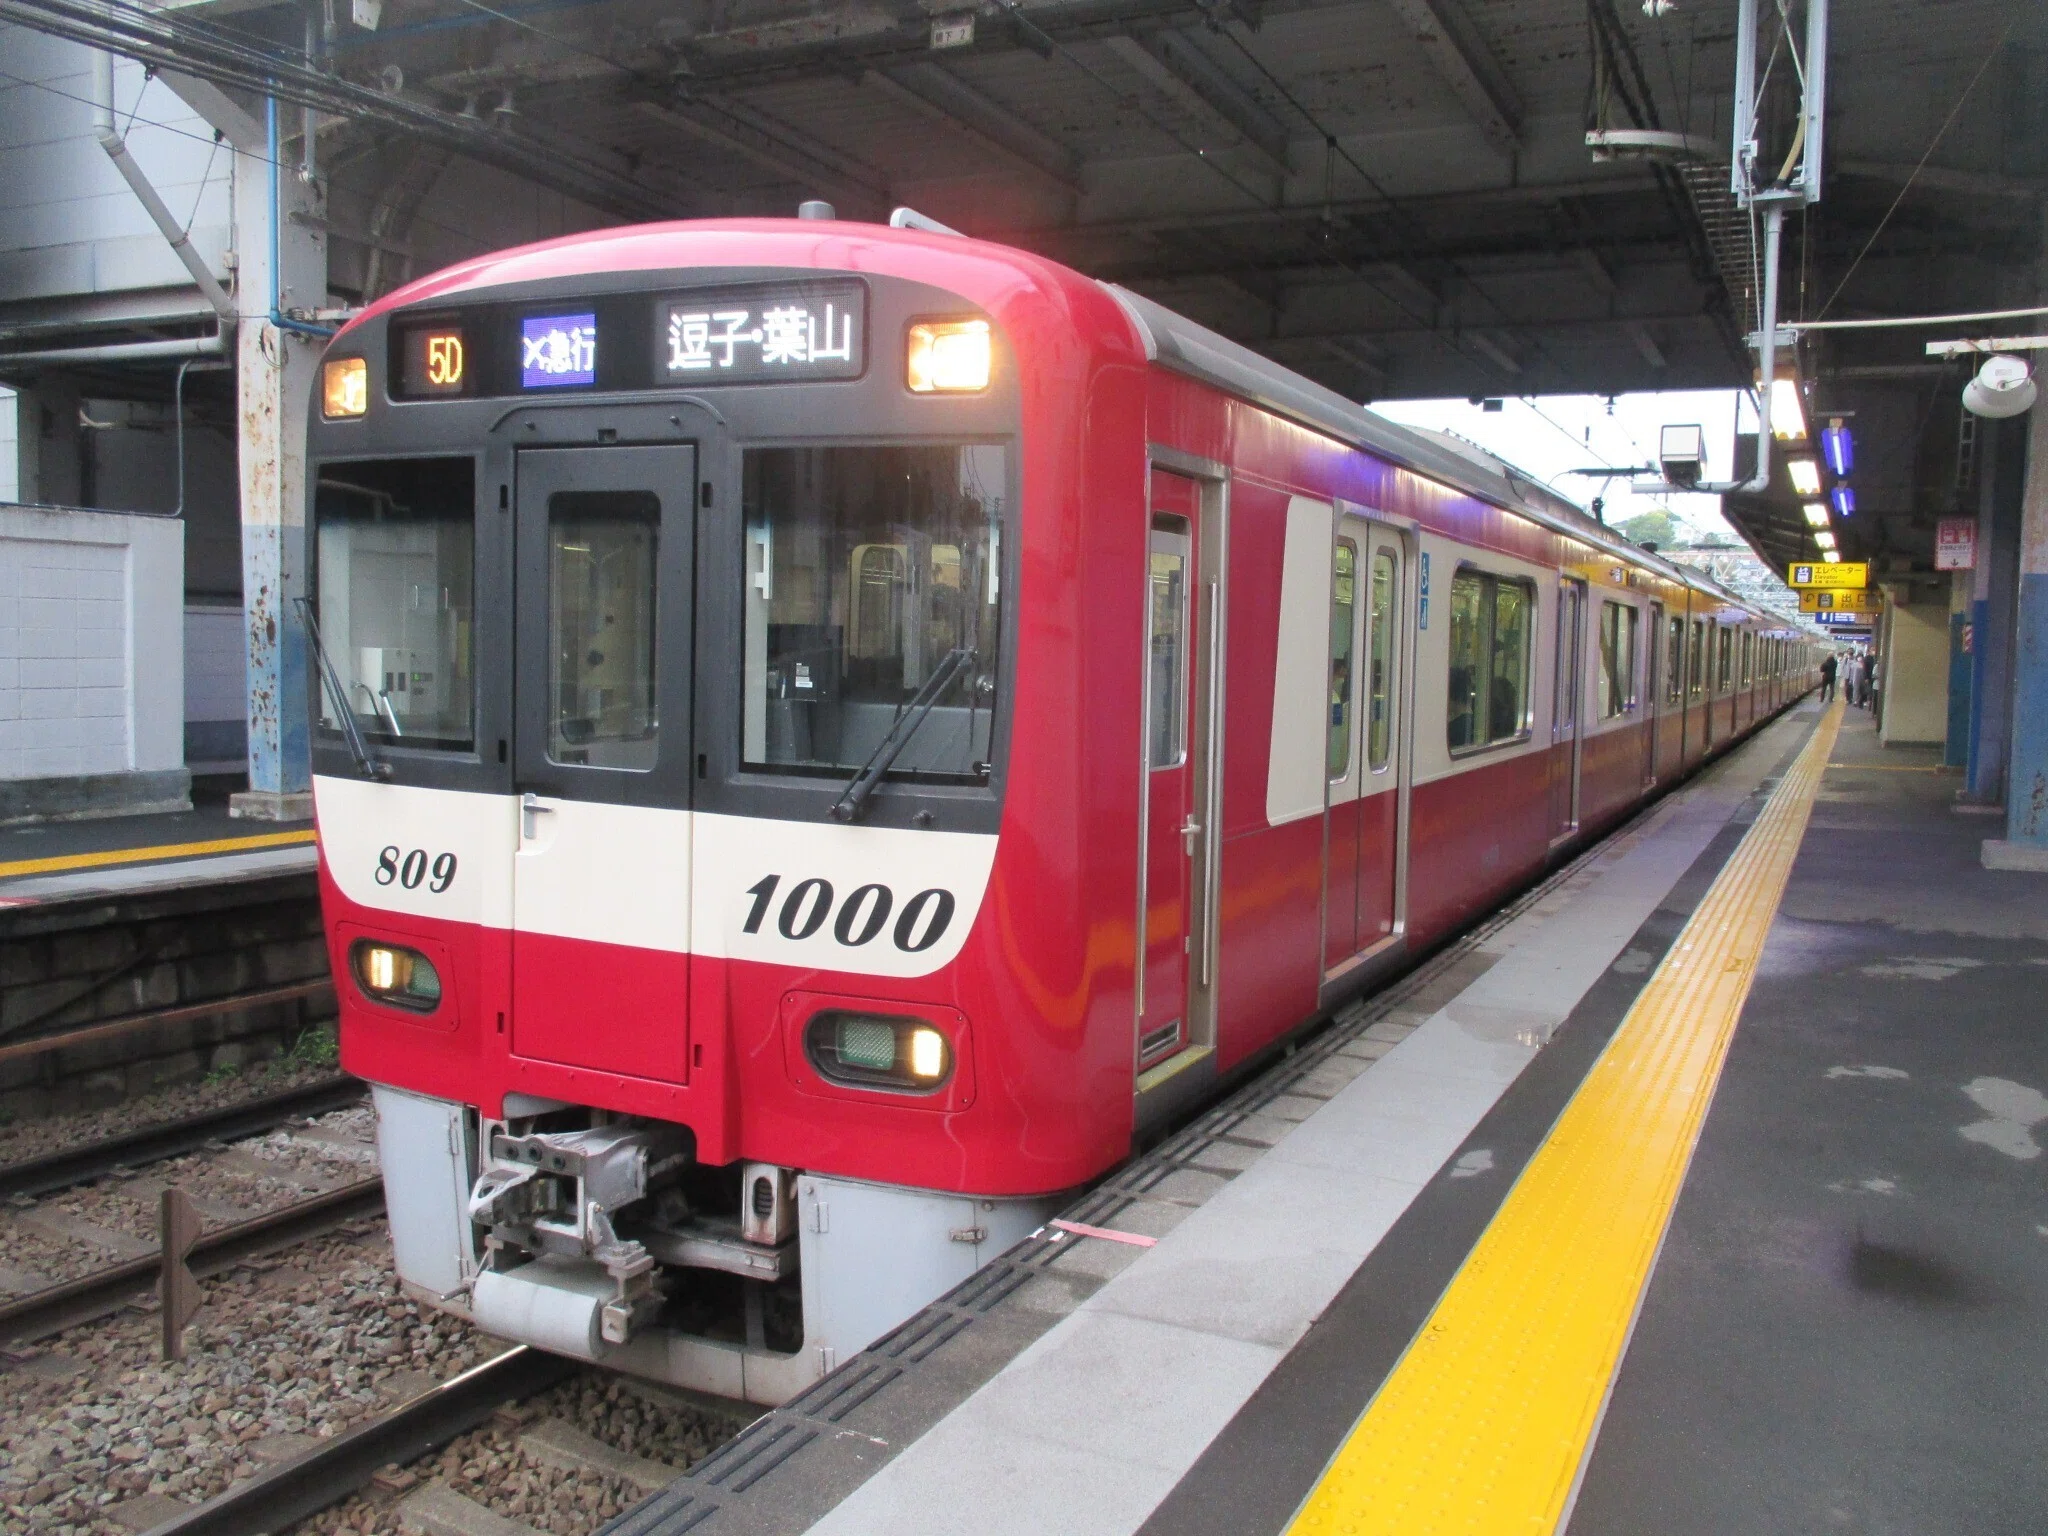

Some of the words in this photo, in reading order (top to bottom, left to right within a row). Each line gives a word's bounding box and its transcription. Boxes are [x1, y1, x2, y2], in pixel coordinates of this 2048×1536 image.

[429, 336, 462, 383] 5D
[668, 303, 850, 369] 逗子・葉山
[1815, 566, 1862, 574] エレベーター
[375, 845, 458, 893] 809
[742, 874, 956, 952] 1000
